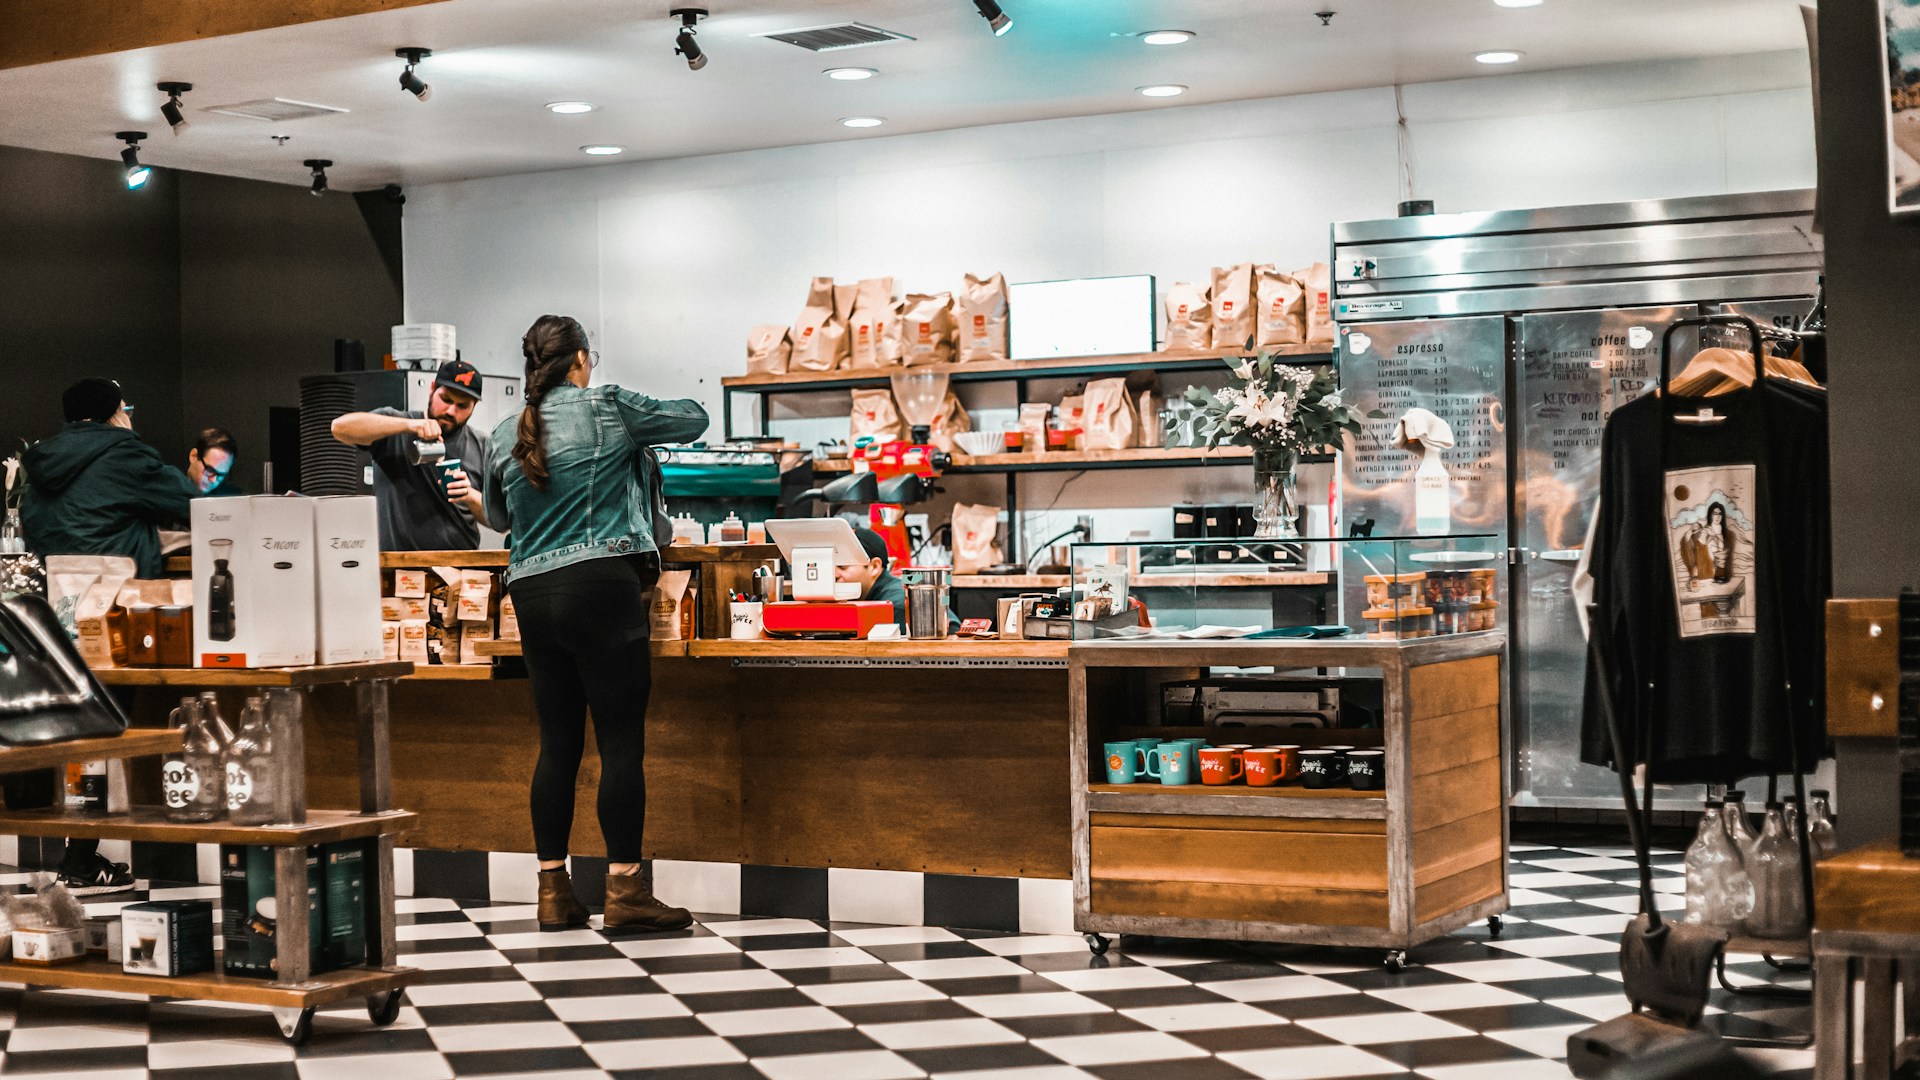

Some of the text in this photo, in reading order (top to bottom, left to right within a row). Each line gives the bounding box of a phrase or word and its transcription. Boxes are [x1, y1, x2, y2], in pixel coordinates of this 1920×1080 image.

[1591, 335, 1626, 347] coffee
[1397, 343, 1444, 355] espresso
[1570, 350, 1593, 358] COFFEE
[1377, 359, 1408, 367] ESPRESSO
[1552, 362, 1569, 370] COLD
[1377, 369, 1408, 378] ESPRESSO
[1378, 379, 1413, 388] AMERICANO
[1621, 379, 1645, 392] RED
[1378, 390, 1411, 398] GIBRALTAR
[1378, 400, 1418, 409] CAPPUCCINO
[1581, 410, 1599, 421] not
[1553, 428, 1567, 436] HOT
[1355, 465, 1385, 473] LAVENDER
[1387, 464, 1412, 472] VANILLA
[1554, 461, 1565, 469] TEA
[208, 513, 232, 522] Encore
[262, 537, 300, 550] Encore
[329, 537, 366, 549] Encore
